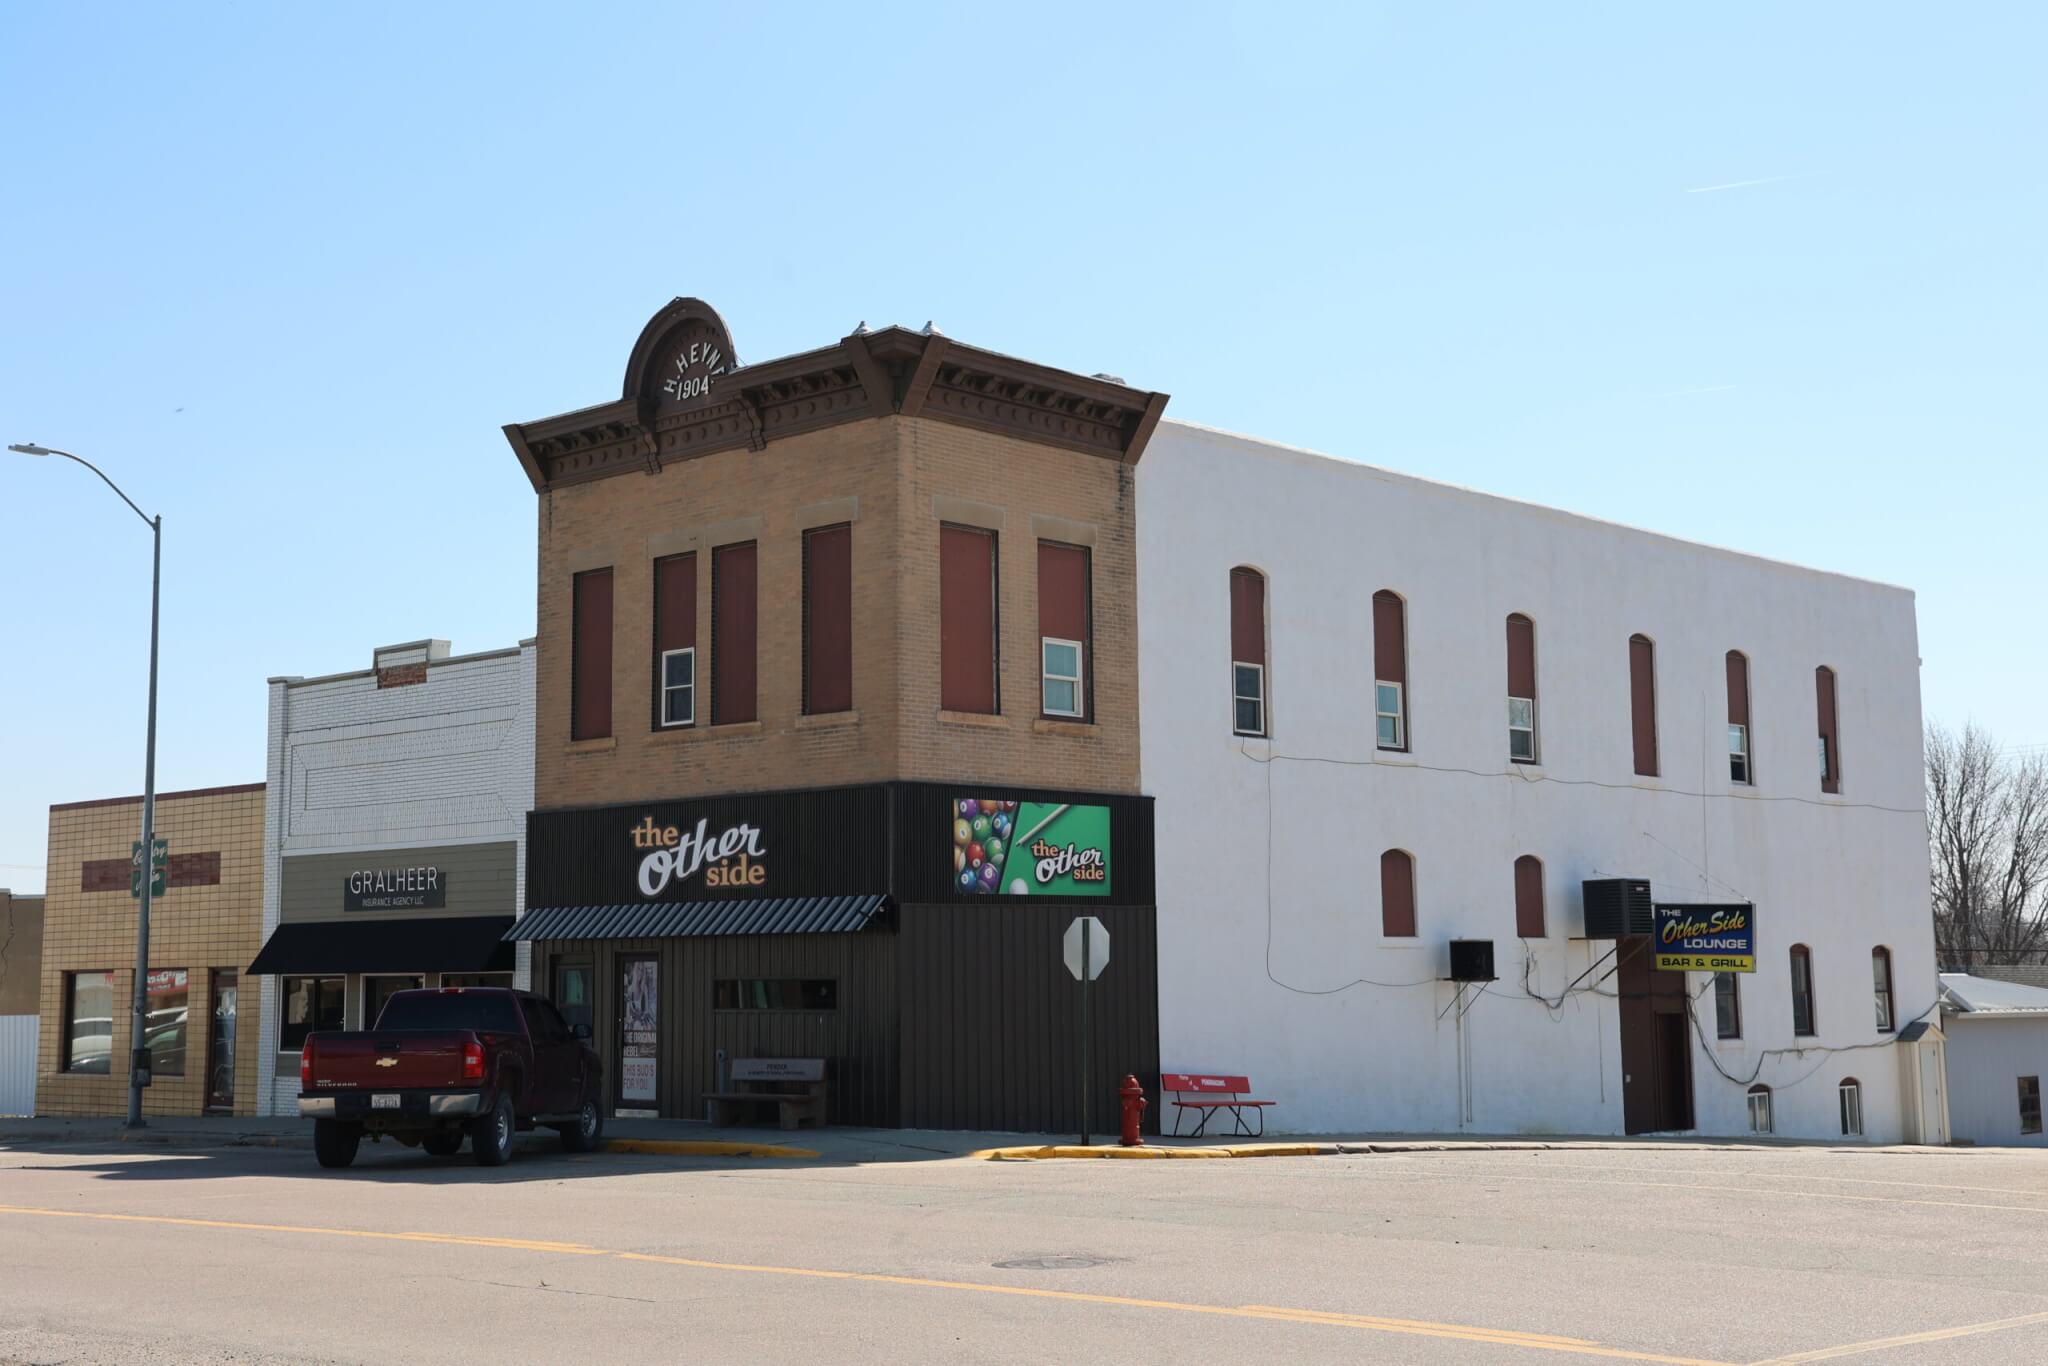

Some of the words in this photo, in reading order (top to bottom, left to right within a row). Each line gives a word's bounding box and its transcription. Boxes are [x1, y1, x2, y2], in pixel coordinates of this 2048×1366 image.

[677, 374, 709, 401] 1904
[631, 816, 679, 848] the
[638, 818, 766, 896] Other
[1031, 840, 1058, 857] the
[706, 853, 765, 886] side
[1036, 844, 1105, 882] Other
[1073, 864, 1104, 880] side
[350, 866, 438, 894] GRALHEER
[362, 896, 391, 907] INSURANCE
[392, 895, 413, 906] AGENCY
[1663, 916, 1709, 944] Other
[1710, 911, 1745, 933] Side
[1684, 939, 1747, 949] LOUNGE
[1662, 958, 1690, 967] BAR
[1695, 957, 1705, 967] &
[1710, 957, 1748, 968] GRILL
